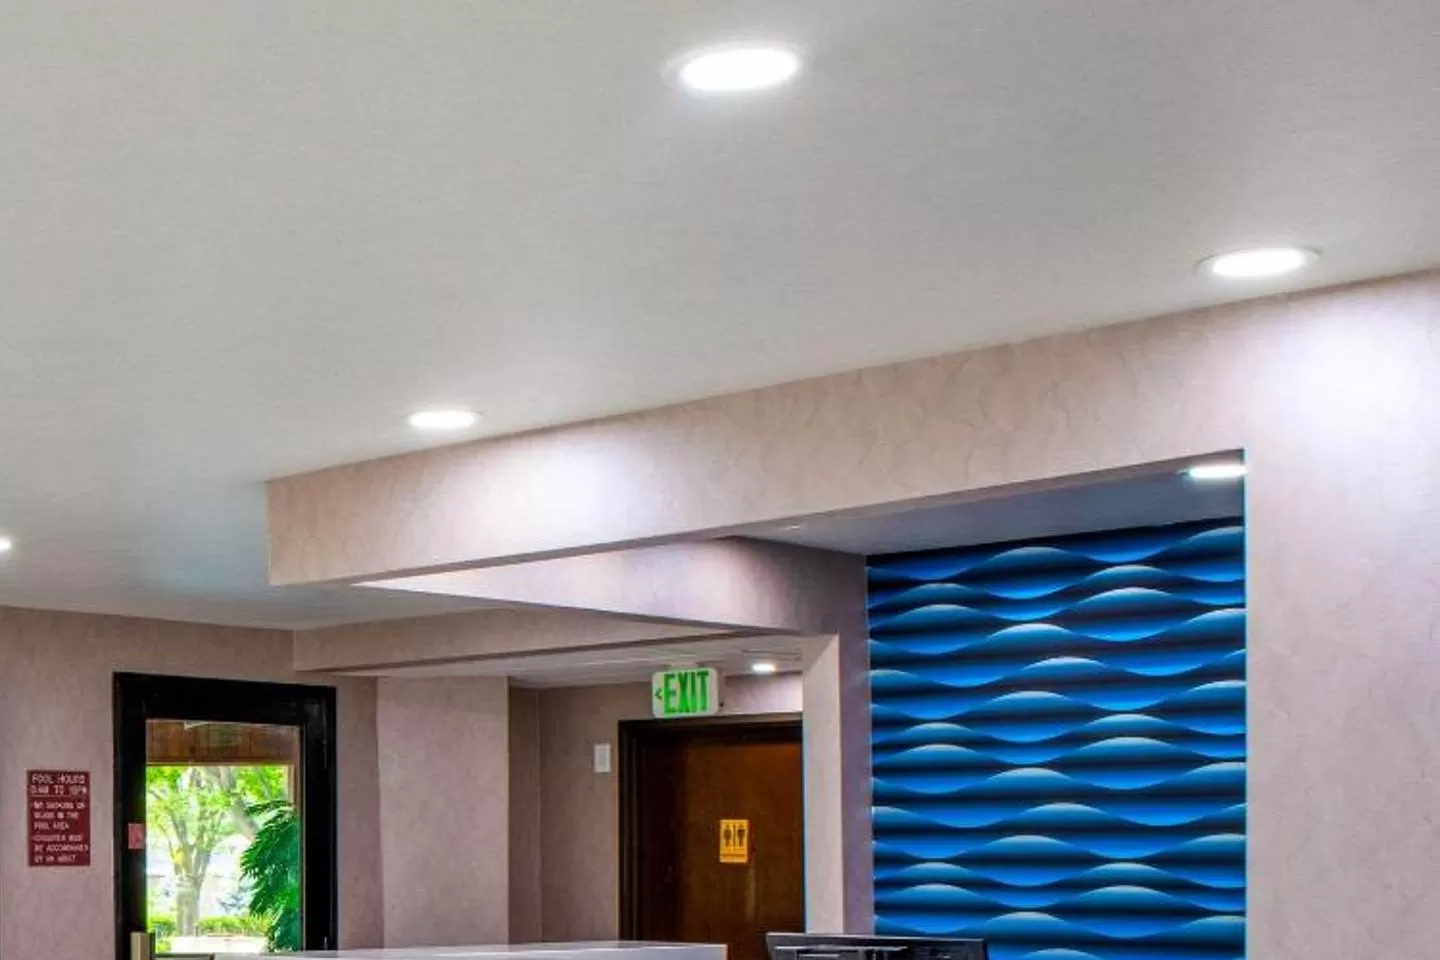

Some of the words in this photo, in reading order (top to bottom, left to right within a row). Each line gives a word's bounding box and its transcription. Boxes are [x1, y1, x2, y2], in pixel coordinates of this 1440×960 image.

[664, 671, 709, 714] EXIT
[31, 773, 54, 784] POOL
[58, 774, 85, 784] HOURS
